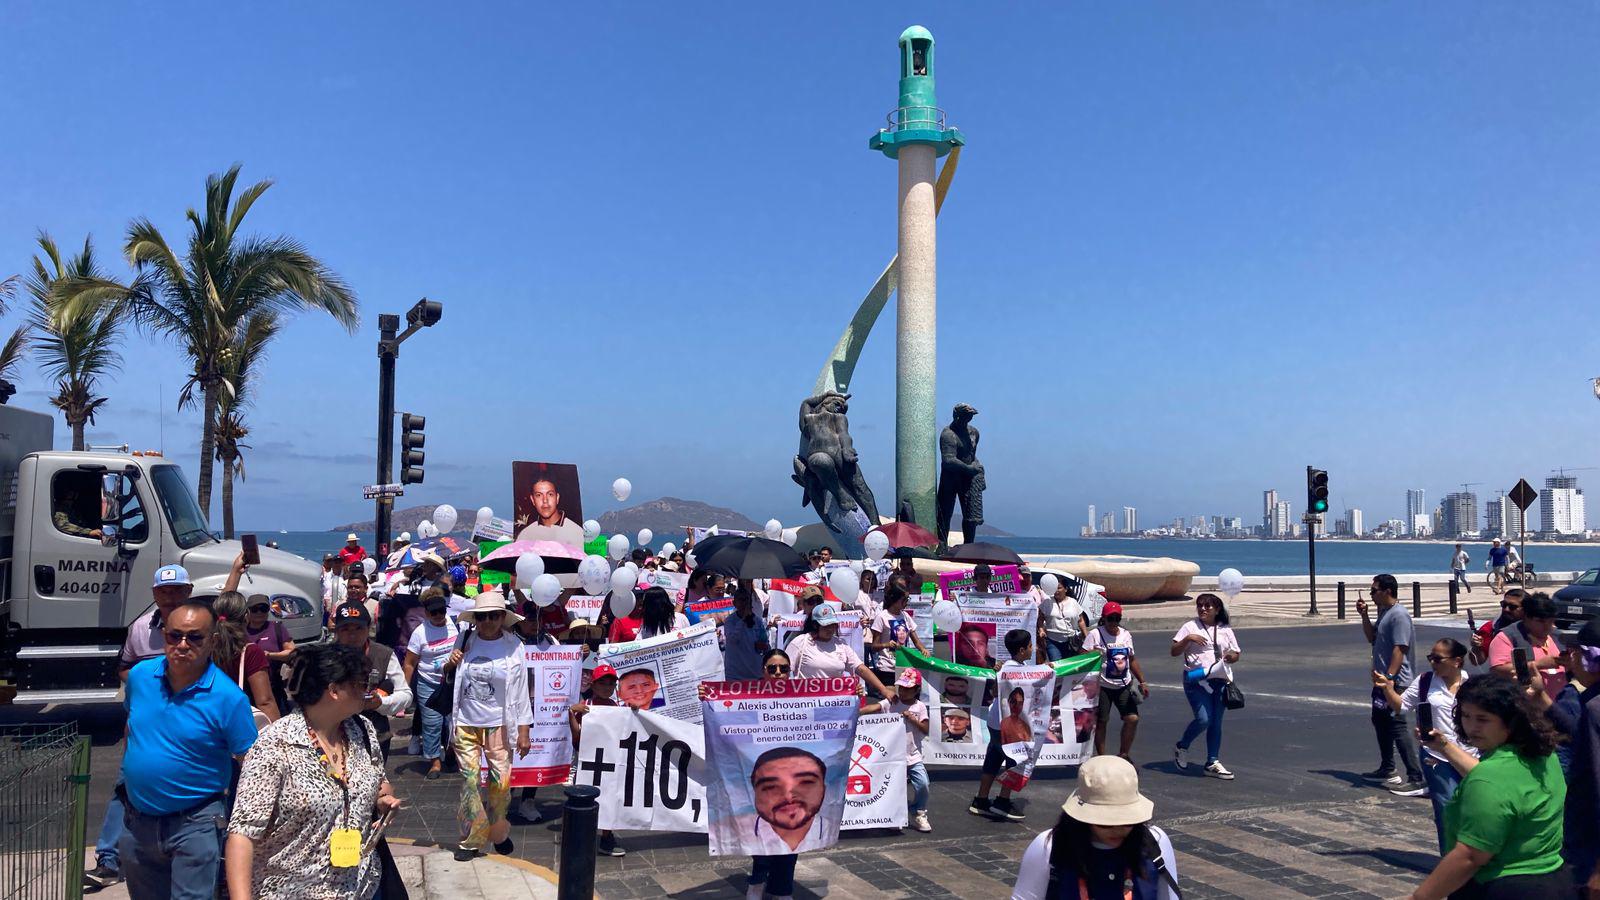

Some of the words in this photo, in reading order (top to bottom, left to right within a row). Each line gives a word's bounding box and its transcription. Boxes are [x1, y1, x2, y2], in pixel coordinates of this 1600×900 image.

[58, 559, 131, 573] MARINA
[60, 582, 121, 594] 404027
[581, 599, 587, 609] A
[749, 680, 786, 695] HAS
[791, 677, 855, 693] VISTO?
[738, 701, 767, 710] Alexis
[769, 700, 817, 710] Jhovanni
[818, 699, 851, 708] Loaiza
[762, 712, 808, 722] Bastidas
[724, 727, 746, 735] Visto
[763, 725, 789, 733] última
[827, 722, 838, 730] 02
[757, 735, 784, 743] enero
[796, 732, 820, 741] 2021.
[934, 752, 967, 760] TESOROS
